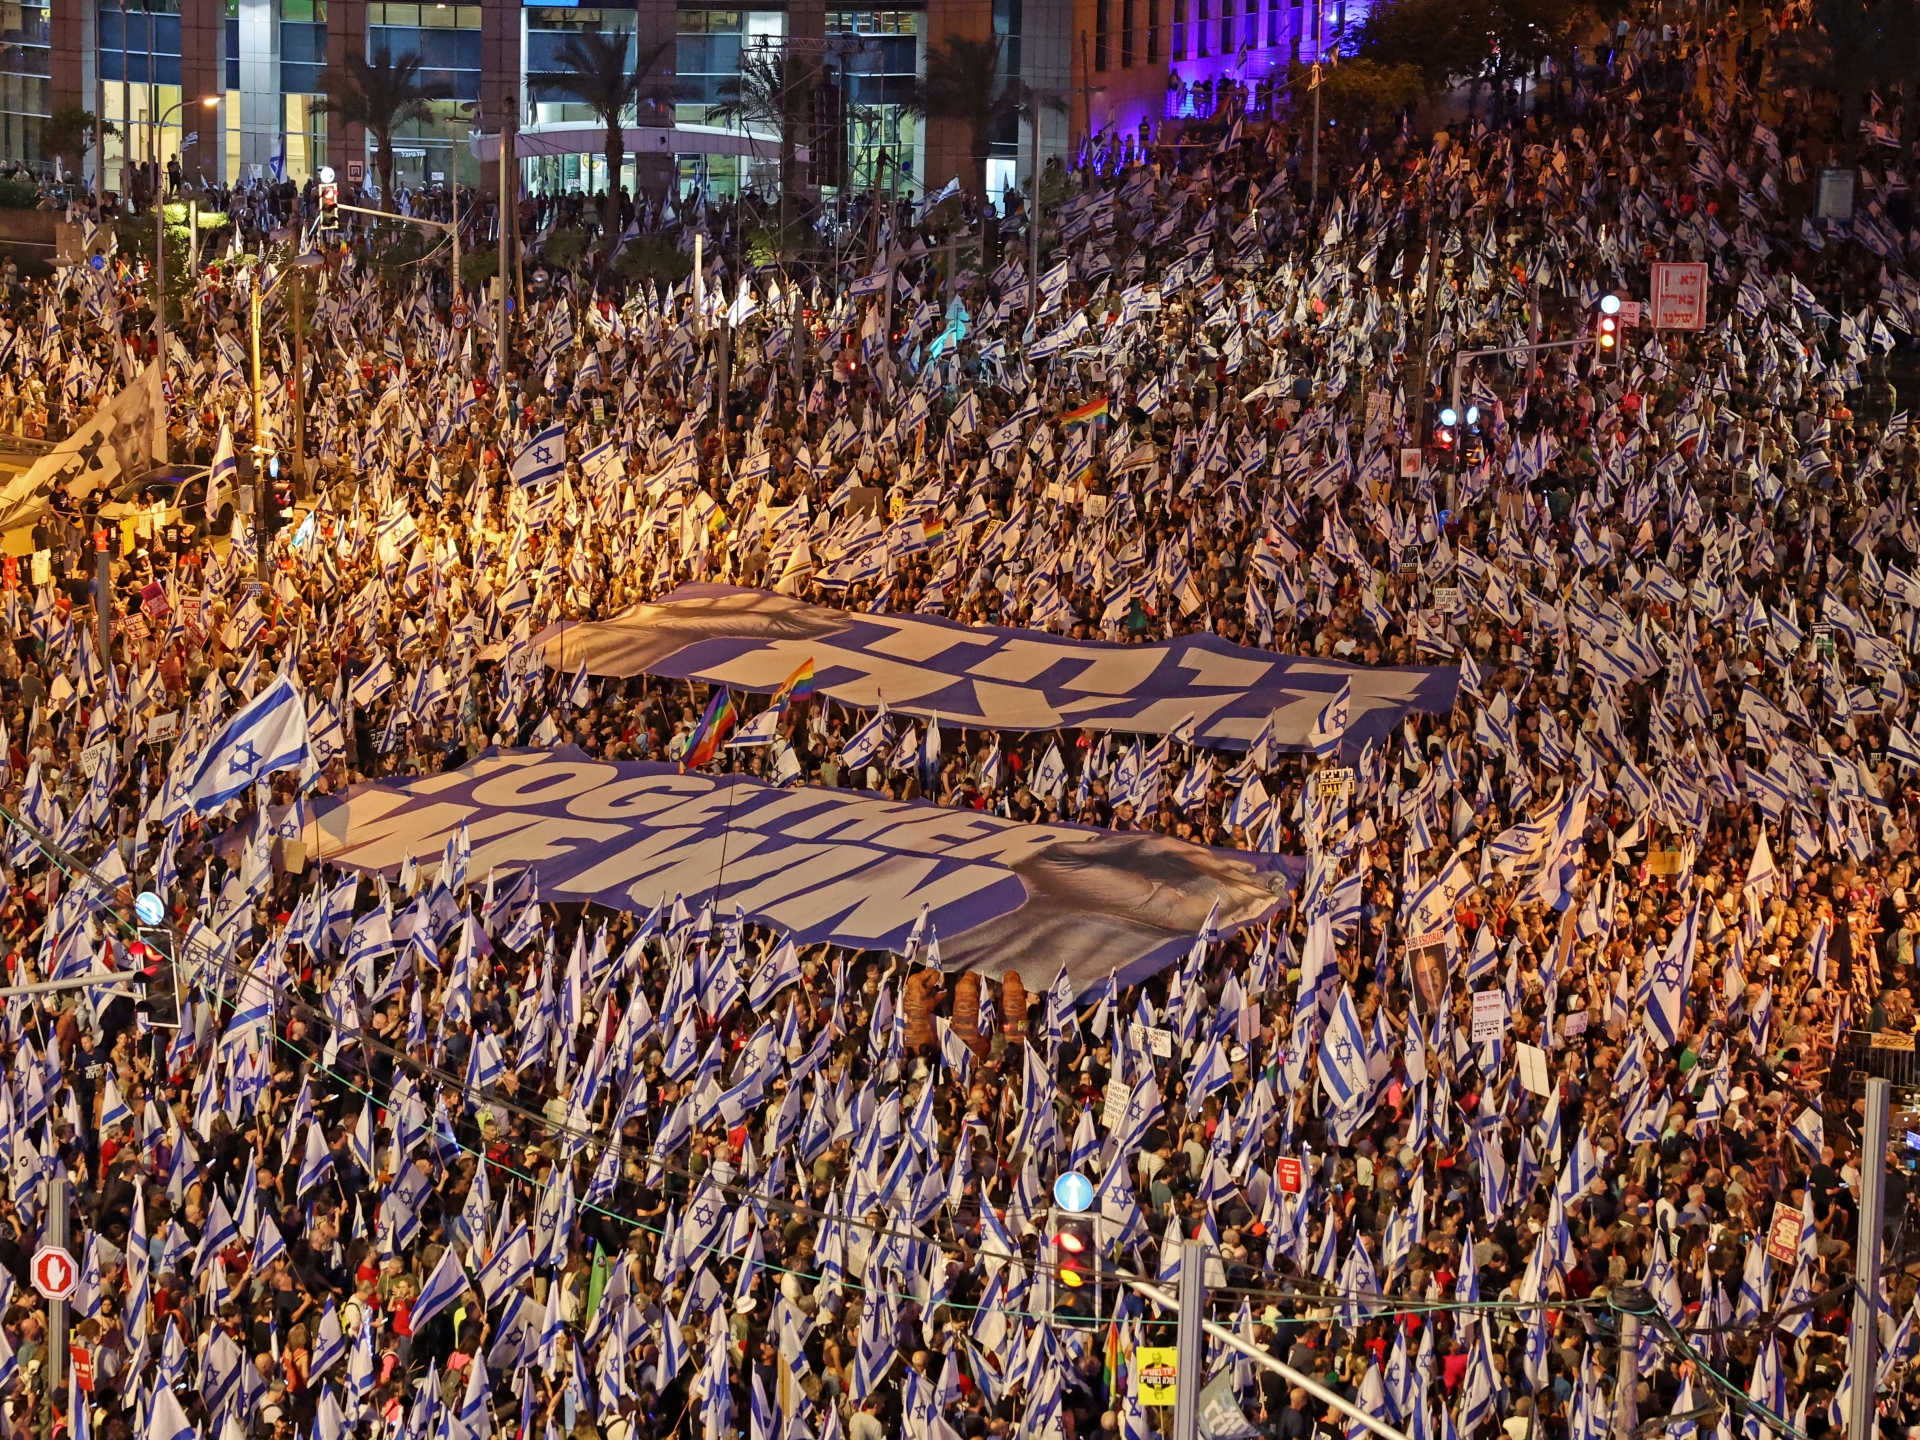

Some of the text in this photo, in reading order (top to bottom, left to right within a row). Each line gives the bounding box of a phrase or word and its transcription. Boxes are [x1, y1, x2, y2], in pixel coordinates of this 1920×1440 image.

[1680, 272, 1697, 286] לא
[1660, 294, 1695, 306] בארץ
[1663, 310, 1692, 324] שלנו
[83, 748, 99, 763] BIBI
[398, 752, 1098, 866] TOGETHER
[306, 790, 1019, 938] WE WIN
[1406, 931, 1444, 949] BIBI ESCOBAR
